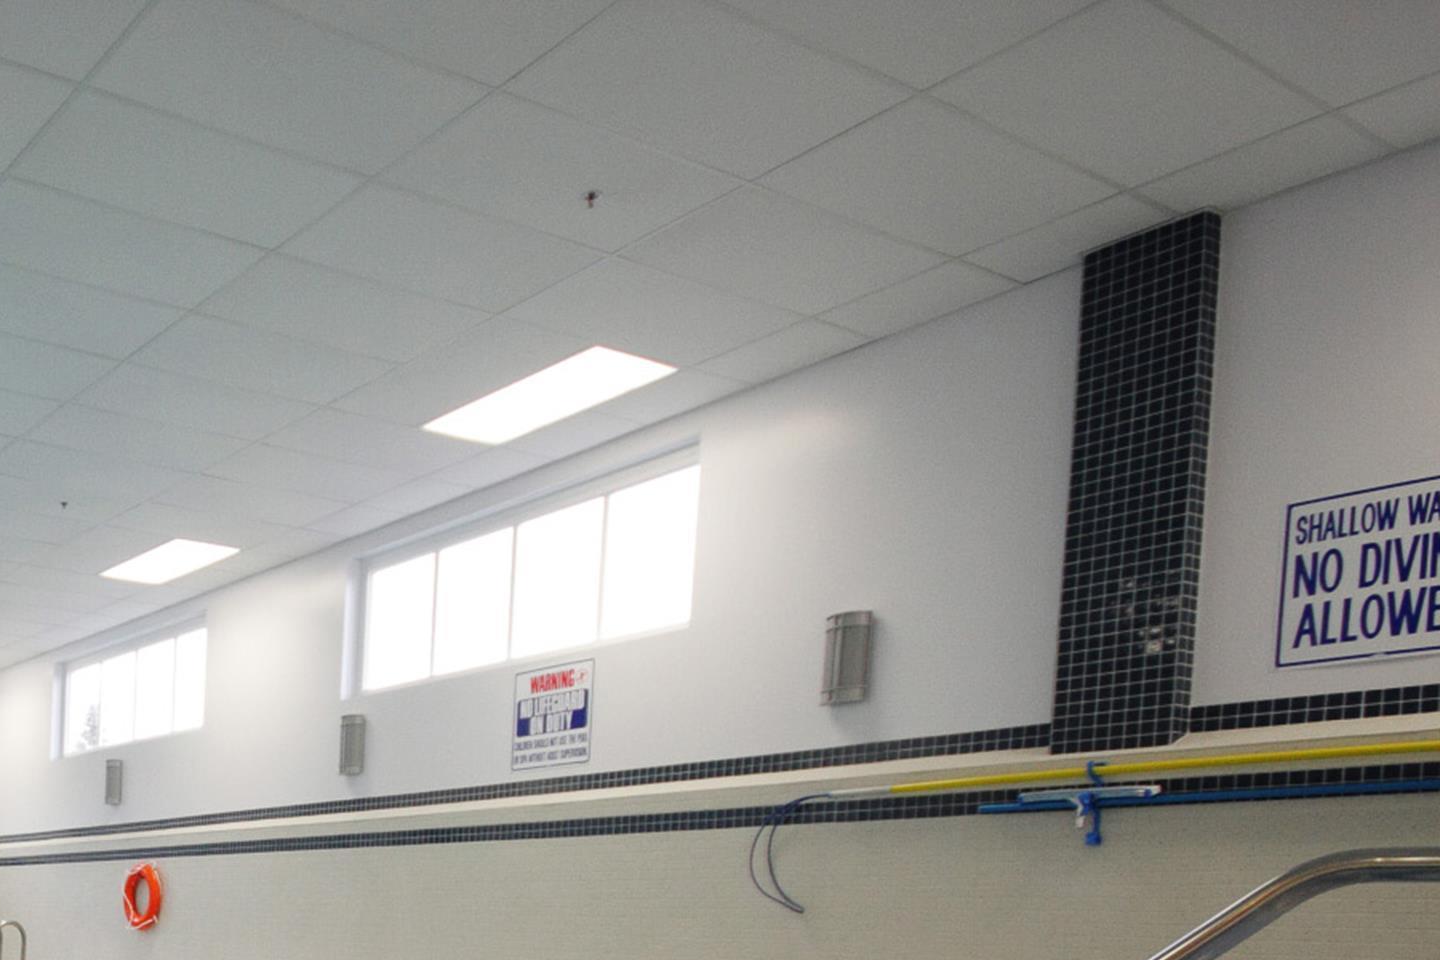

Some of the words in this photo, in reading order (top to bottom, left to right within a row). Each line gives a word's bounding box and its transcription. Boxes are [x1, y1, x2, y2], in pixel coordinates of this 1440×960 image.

[1295, 497, 1400, 545] SHALLOW
[1293, 548, 1344, 599] NO
[530, 668, 575, 694] WARNING
[545, 710, 574, 733] DUTY
